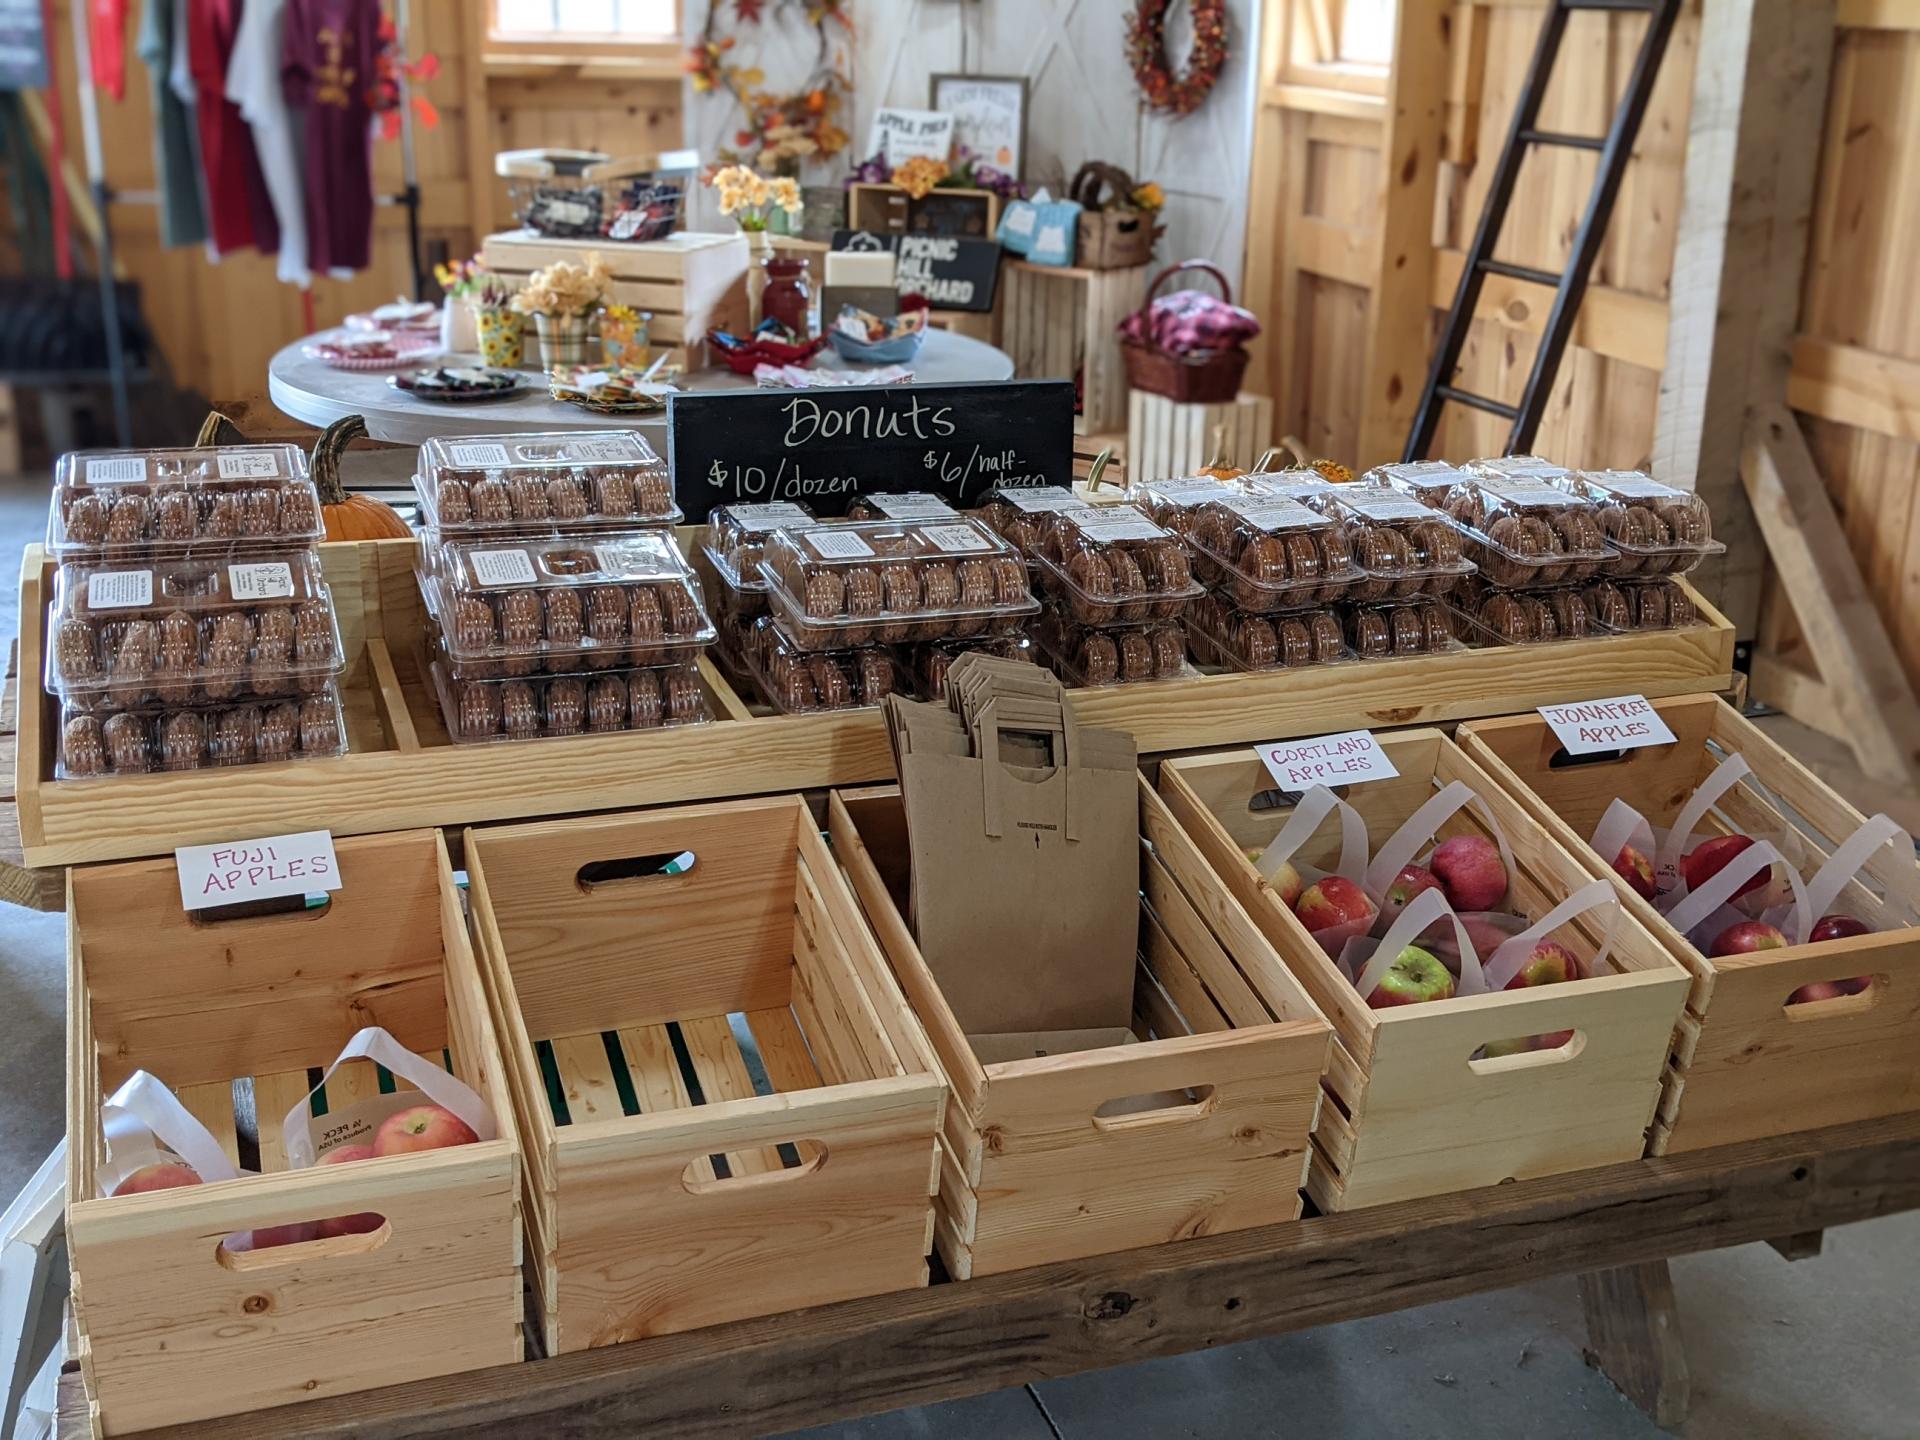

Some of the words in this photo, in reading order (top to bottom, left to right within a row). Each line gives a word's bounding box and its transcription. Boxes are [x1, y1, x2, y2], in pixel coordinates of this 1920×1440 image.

[901, 236, 959, 261] PICNIC
[897, 257, 934, 279] HILL
[896, 277, 975, 303] ORCHARD
[781, 395, 956, 447] Donuts
[707, 457, 858, 500] $10/dozen
[1545, 700, 1651, 724] JONAFREE
[1579, 722, 1651, 743] APPLES
[1270, 737, 1372, 765] CORTLAND
[1287, 757, 1373, 783] APPLES
[212, 846, 277, 868] FUJI
[203, 856, 329, 894] APPLES
